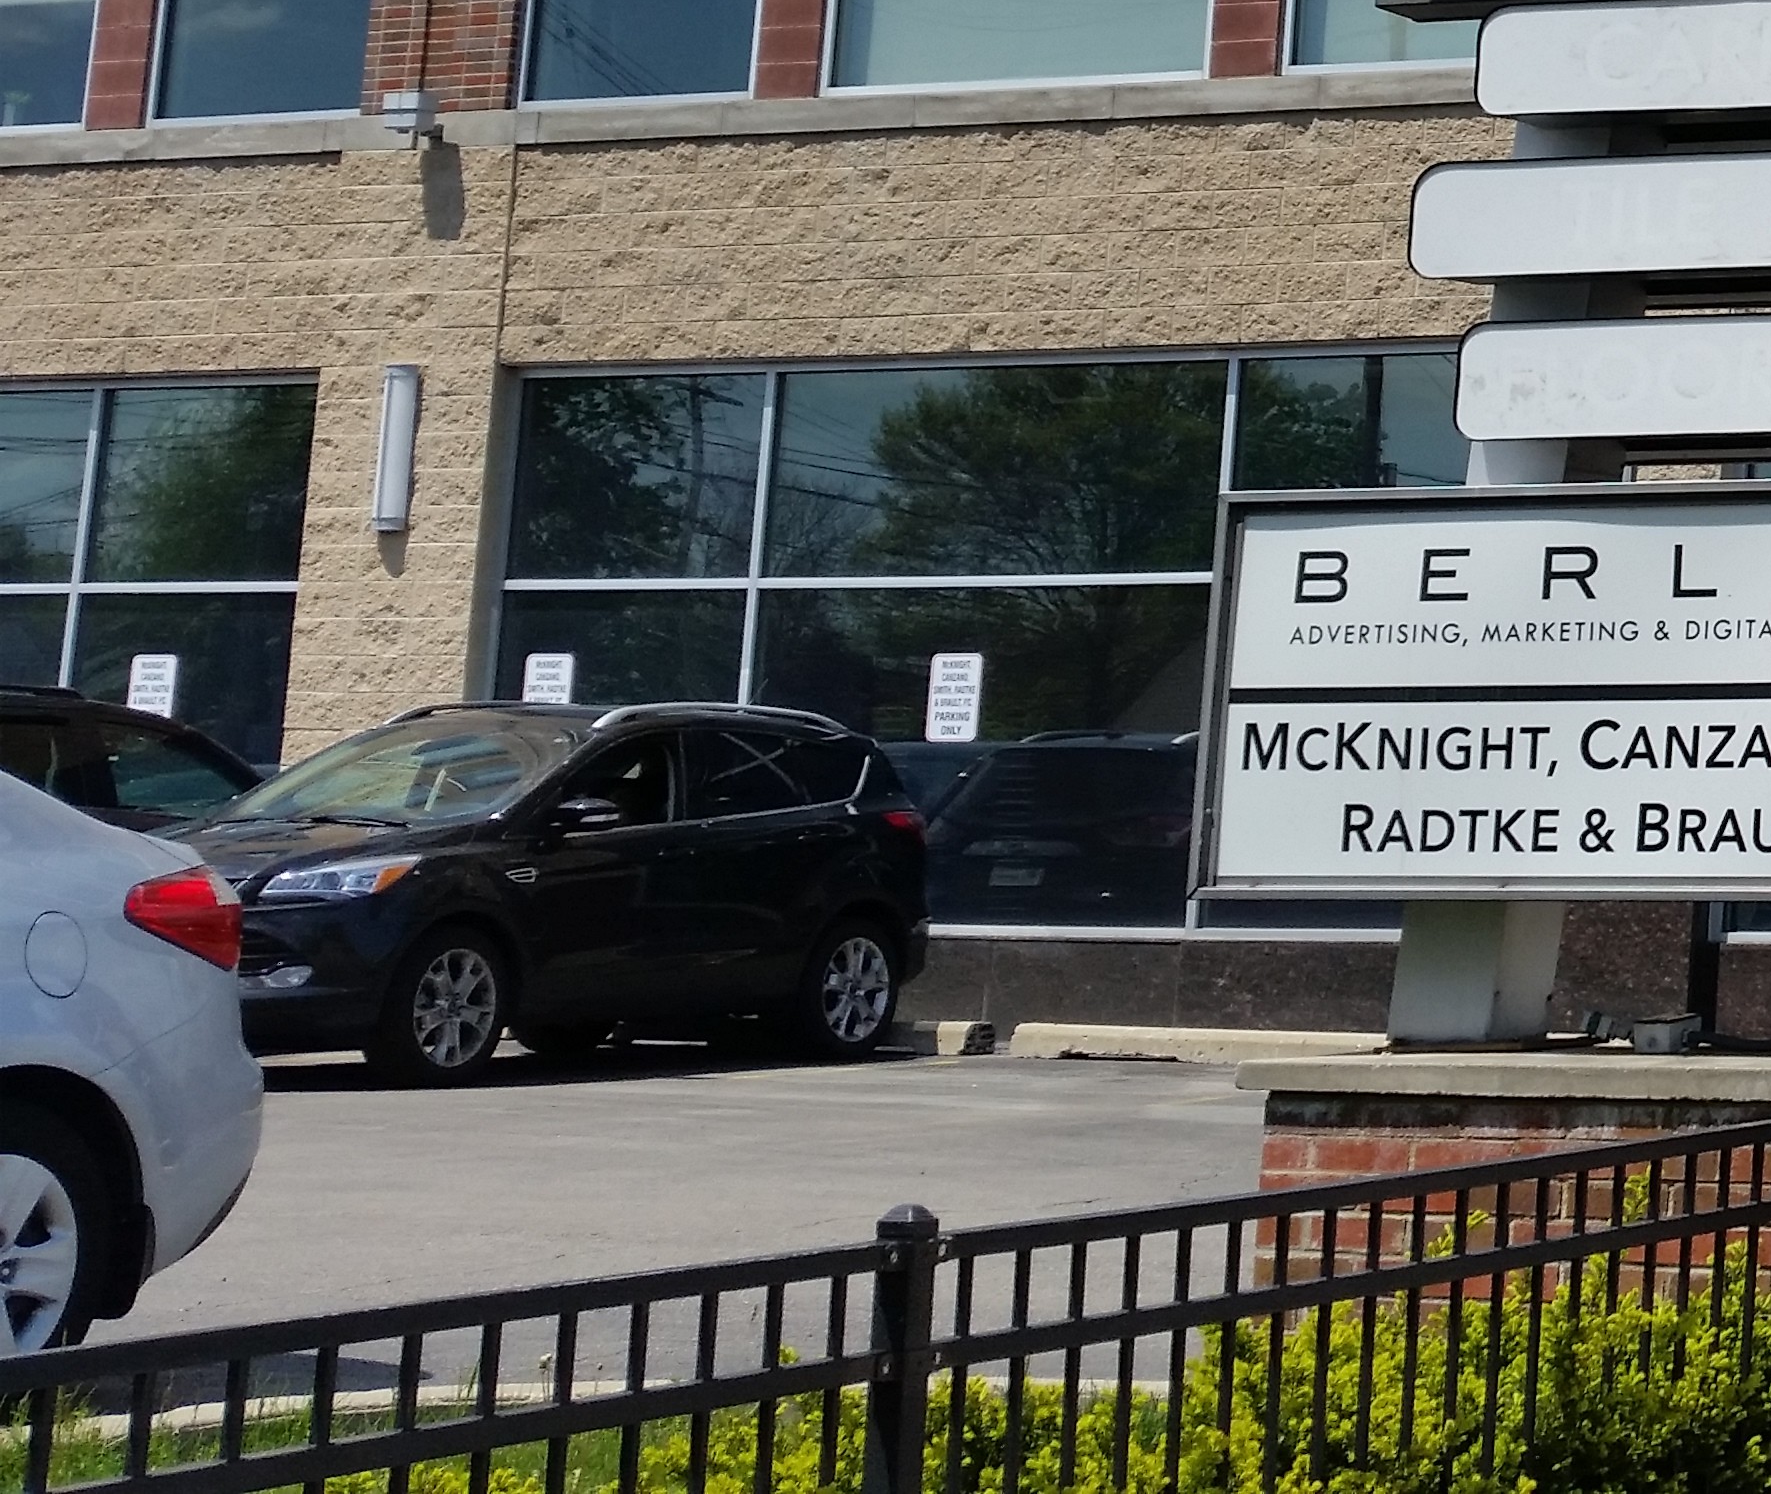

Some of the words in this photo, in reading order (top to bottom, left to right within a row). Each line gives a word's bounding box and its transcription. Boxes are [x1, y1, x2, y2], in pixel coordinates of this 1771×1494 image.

[1289, 623, 1468, 647] ADVERTISING,
[1481, 620, 1639, 643] MARKETING
[1654, 620, 1670, 641] &
[934, 711, 970, 721] PARKING
[941, 725, 961, 735] ONLY
[1341, 803, 1560, 853] RADTKE
[1579, 808, 1616, 854] &
